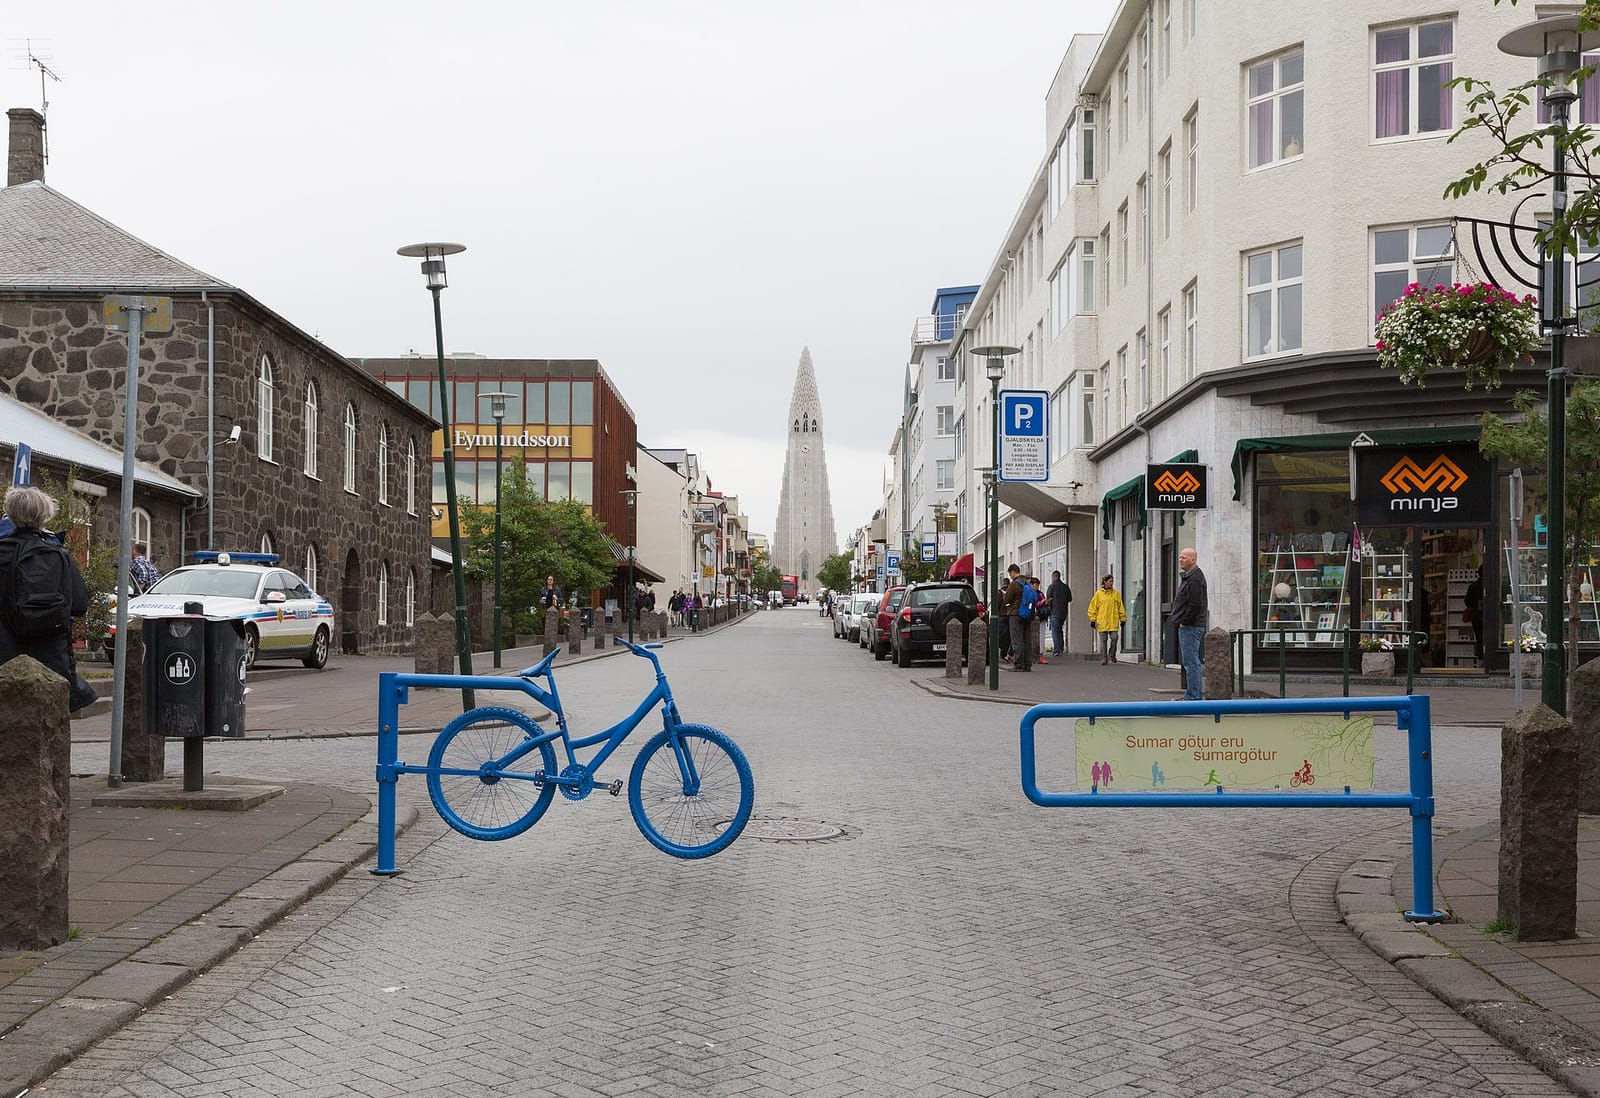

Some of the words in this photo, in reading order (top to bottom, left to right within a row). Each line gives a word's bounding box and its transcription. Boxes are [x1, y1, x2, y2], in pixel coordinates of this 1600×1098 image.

[454, 430, 570, 450] Eymundsson
[1159, 495, 1195, 503] minja
[1391, 497, 1458, 512] minja
[1126, 735, 1174, 748] Sumar
[1178, 735, 1216, 751] götur
[1220, 737, 1244, 747] eru
[1193, 748, 1277, 764] sumargötur
